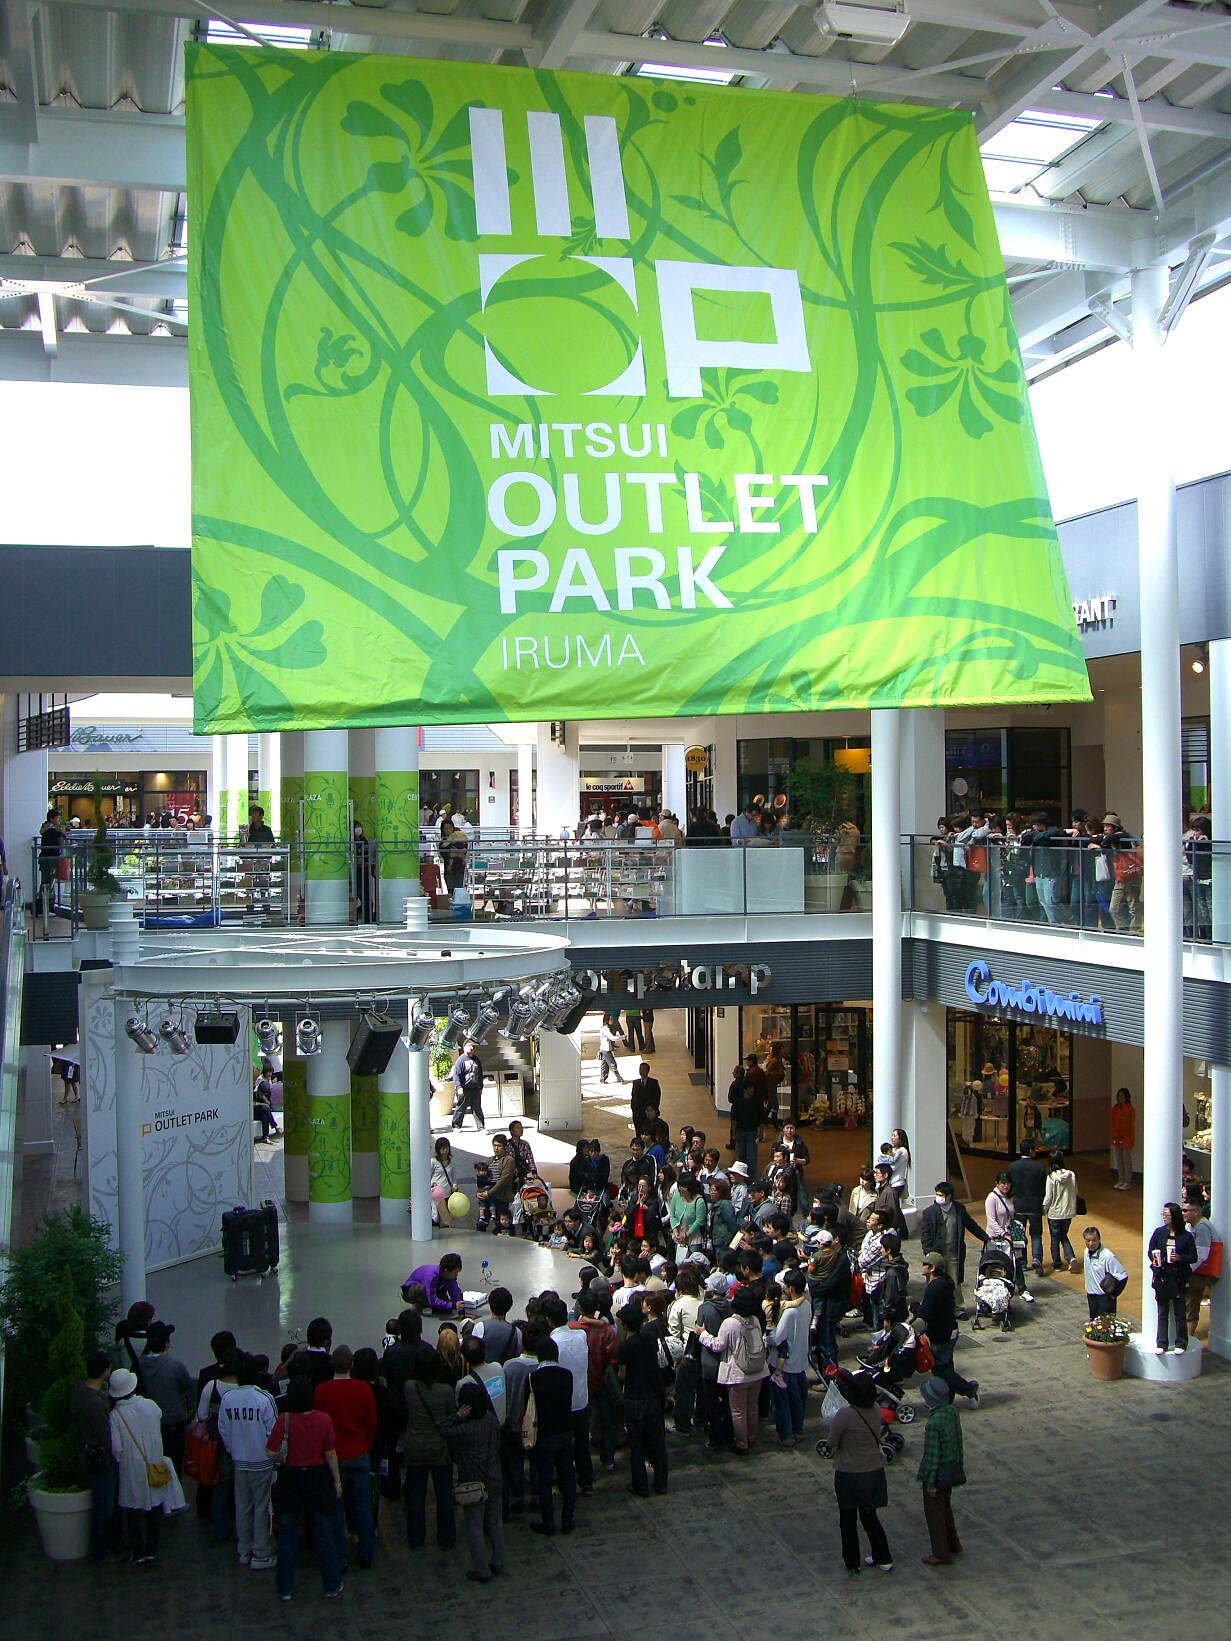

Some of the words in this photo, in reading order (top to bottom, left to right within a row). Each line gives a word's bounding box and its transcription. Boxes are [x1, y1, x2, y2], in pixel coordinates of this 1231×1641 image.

[489, 423, 669, 459] MITSUI
[486, 471, 829, 537] OUTLET
[496, 545, 735, 615] PARK
[501, 633, 647, 671] IRUMA
[49, 780, 82, 793] Eddie
[585, 783, 591, 791] le
[592, 784, 603, 792] coq
[604, 783, 624, 792] sportif
[154, 1114, 193, 1132] OUTLET
[194, 1108, 219, 1124] PARK
